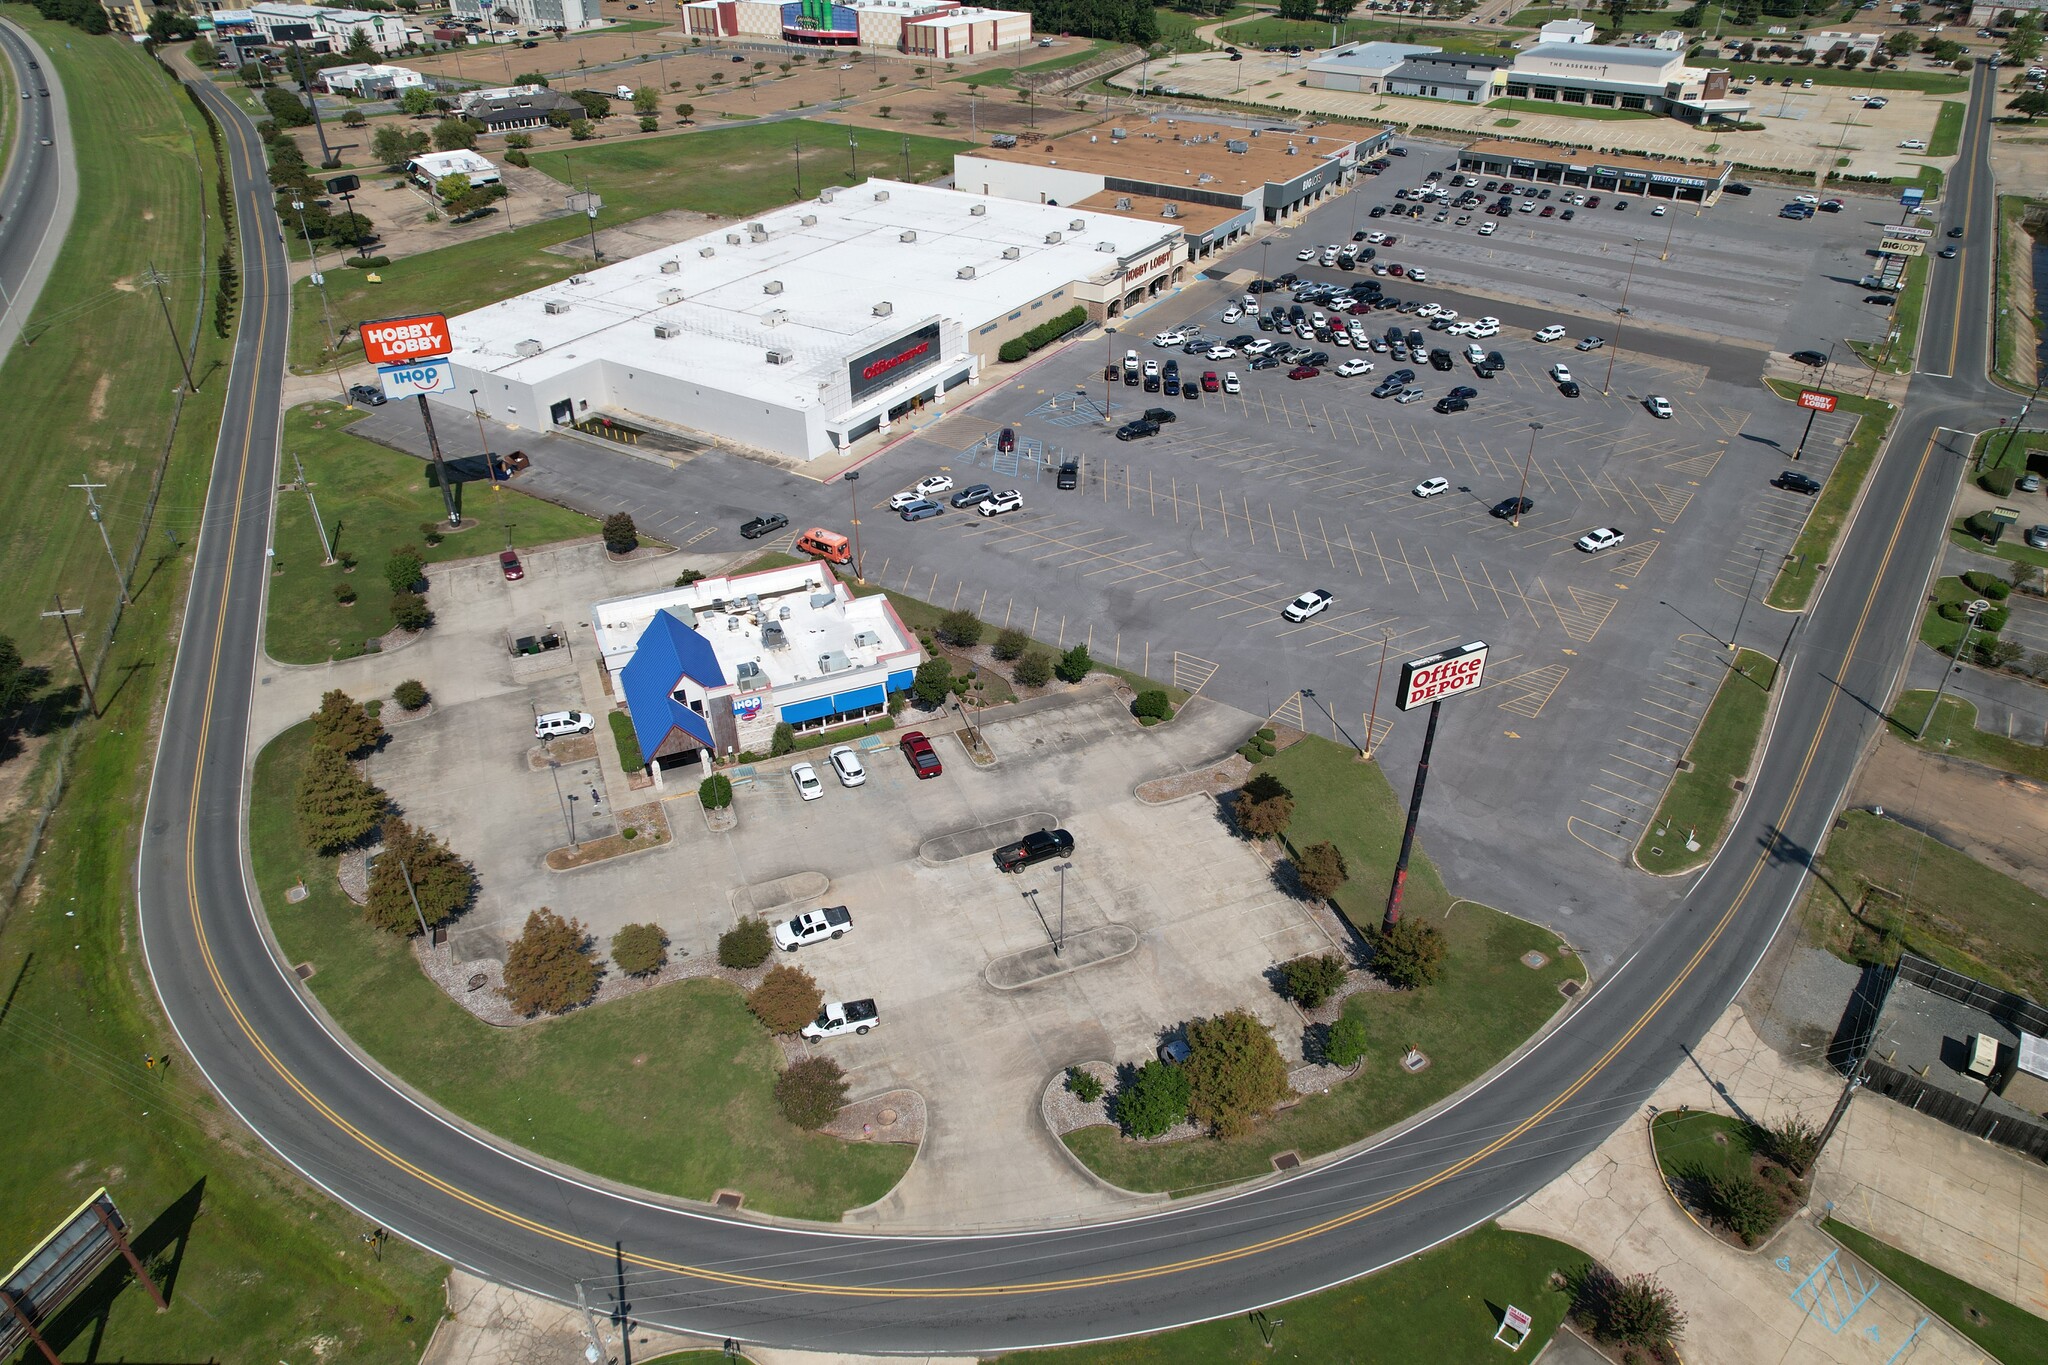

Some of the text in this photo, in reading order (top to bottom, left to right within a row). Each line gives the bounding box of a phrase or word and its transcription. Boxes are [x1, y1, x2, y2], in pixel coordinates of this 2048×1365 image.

[1126, 250, 1170, 283] HOBBY LOBBY
[368, 322, 434, 344] HOBBY
[381, 335, 442, 356] LOBBY
[394, 368, 438, 384] IHOP
[1802, 393, 1832, 404] HOBBY
[1804, 400, 1832, 410] LOBBY
[1412, 658, 1482, 688] Office
[1410, 672, 1478, 704] DEPOT
[734, 698, 760, 710] IHOP
[1517, 1312, 1529, 1320] LEASE
